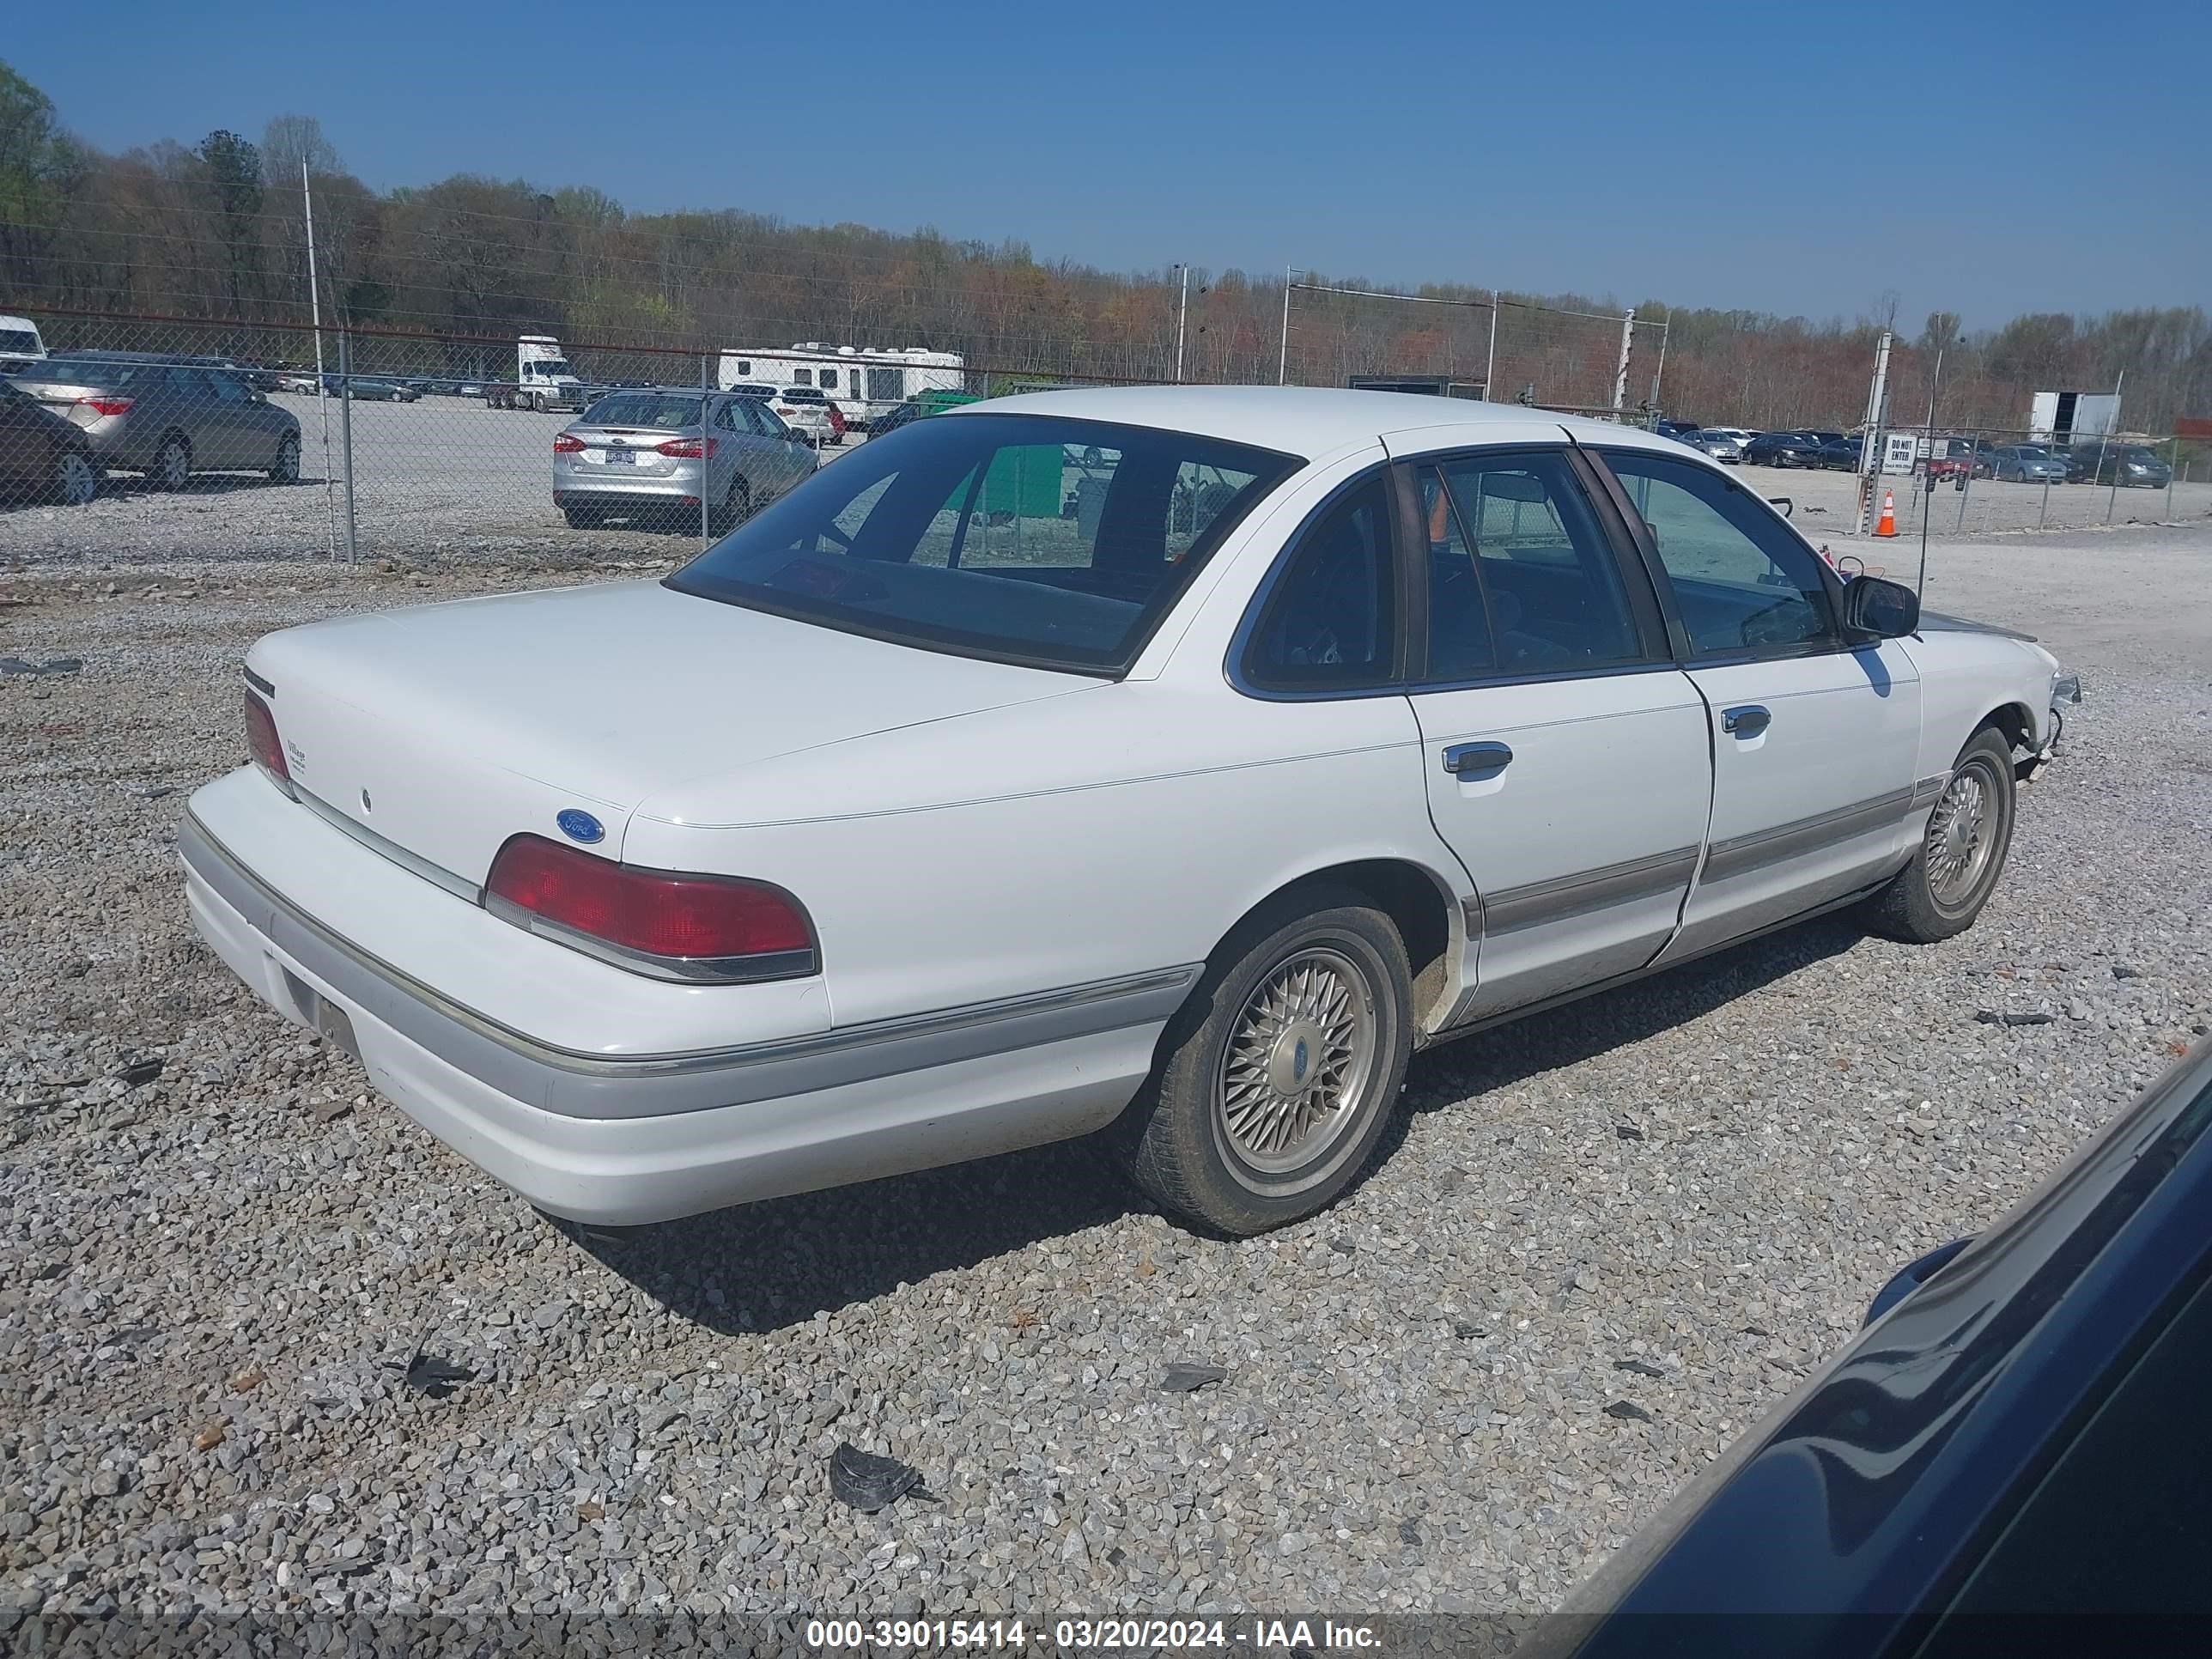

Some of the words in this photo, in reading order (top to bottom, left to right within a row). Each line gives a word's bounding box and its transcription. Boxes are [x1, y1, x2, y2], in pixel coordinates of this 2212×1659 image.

[1892, 439, 1900, 449] DO
[1901, 440, 1912, 450] NOT
[1892, 451, 1909, 461] ENTER
[565, 814, 591, 836] Ford
